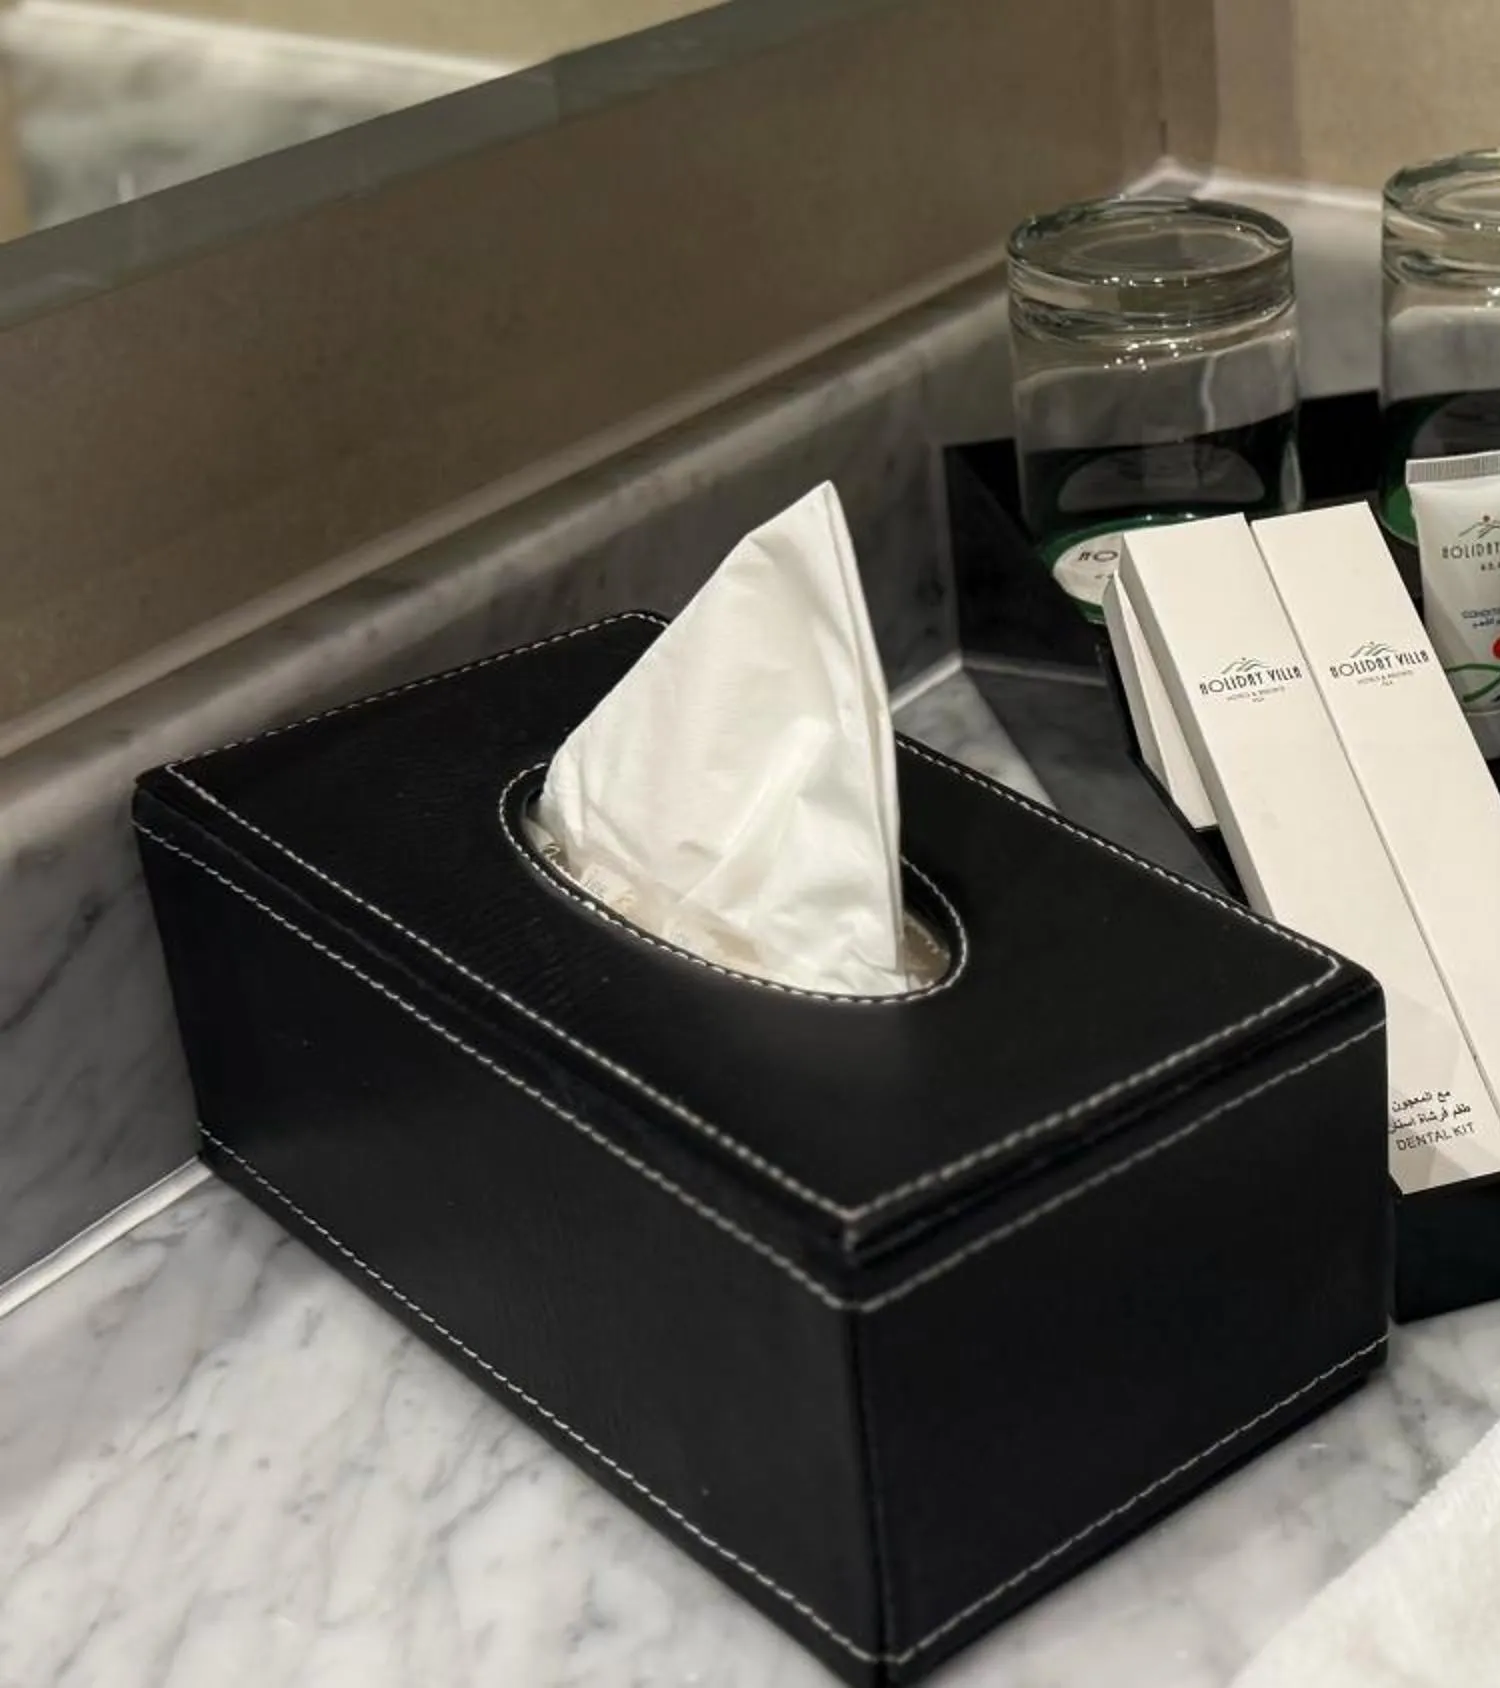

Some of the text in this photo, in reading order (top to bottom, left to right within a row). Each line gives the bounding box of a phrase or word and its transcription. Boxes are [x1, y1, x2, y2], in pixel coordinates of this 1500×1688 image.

[1441, 541, 1500, 560] HOLIDAY
[1329, 650, 1429, 679] HOLIDAY VILLA
[1199, 666, 1303, 695] HOLIDAY VILLA
[1395, 1121, 1475, 1151] DENTAL KIT
